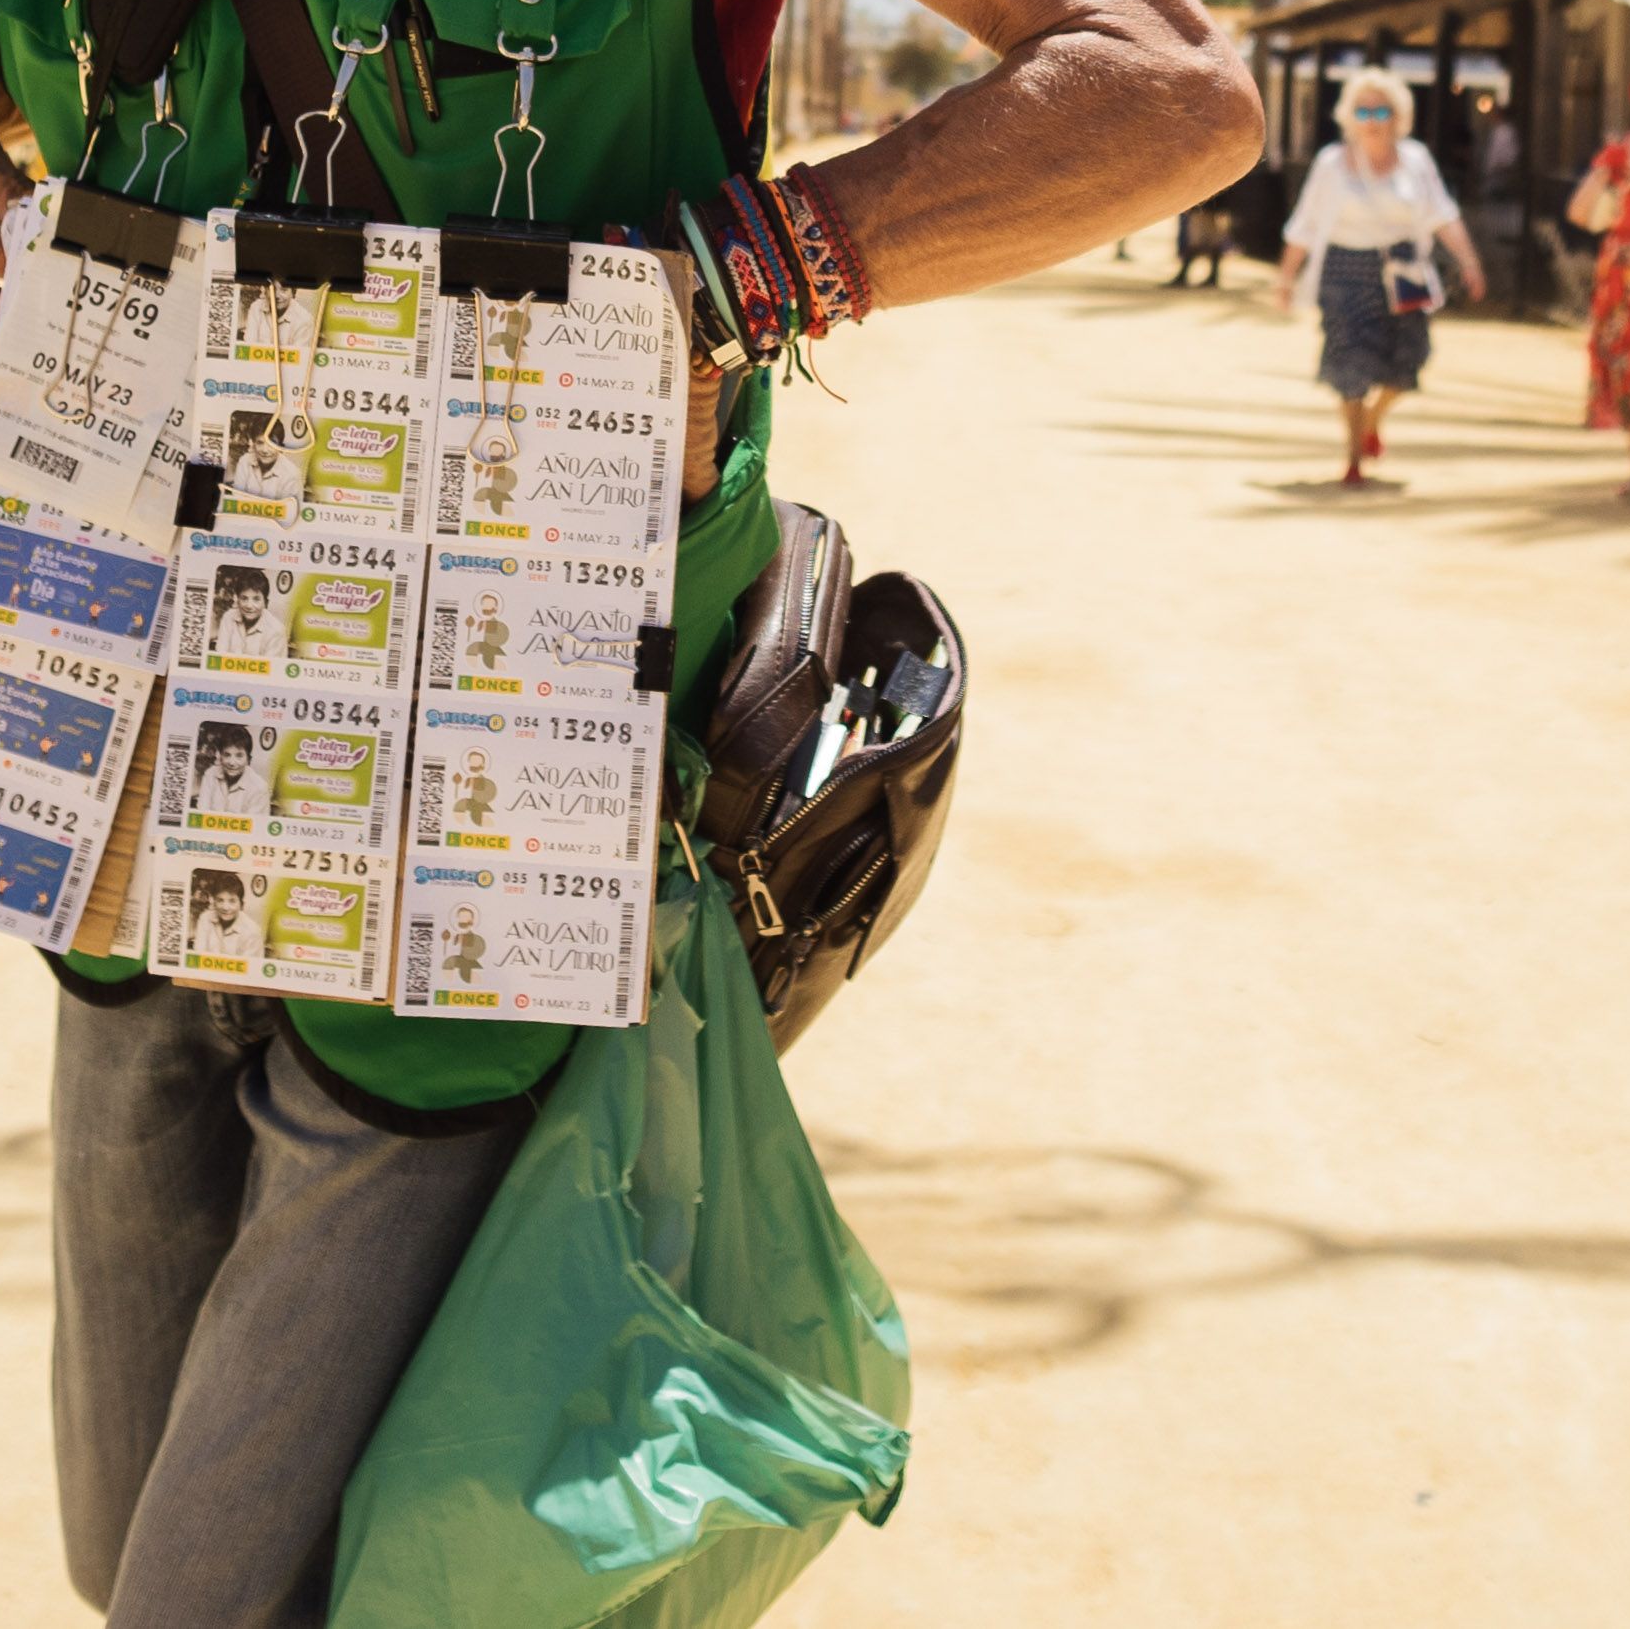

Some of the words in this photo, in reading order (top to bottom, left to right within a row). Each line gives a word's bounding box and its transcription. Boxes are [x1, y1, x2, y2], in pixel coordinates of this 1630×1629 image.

[364, 237, 422, 262] 344
[120, 270, 165, 297] DARIO
[72, 274, 159, 327] 05769
[252, 347, 297, 363] ONCE
[332, 357, 345, 367] 13
[377, 362, 391, 371] 23
[32, 352, 57, 374] 09
[107, 383, 133, 406] 23
[576, 377, 589, 387] 14
[622, 381, 635, 391] 23
[323, 388, 409, 416] 08344
[536, 406, 561, 419] 052
[571, 407, 655, 436] 24653
[98, 418, 137, 448] EUR
[349, 427, 378, 439] letra
[151, 439, 187, 470] EUR
[341, 440, 382, 454] mujer
[242, 502, 286, 517] ONCE
[321, 511, 333, 521] 13
[365, 515, 378, 525] 23
[483, 523, 527, 538] ONCE
[562, 532, 575, 541] 14
[607, 536, 621, 545] 23
[279, 541, 303, 553] 053
[309, 542, 396, 571] 08344
[527, 559, 552, 571] 053
[562, 560, 645, 588] 13298
[334, 582, 363, 594] letra
[325, 595, 367, 609] mujer
[99, 640, 113, 652] 23
[32, 649, 122, 695] 10452
[224, 658, 267, 673] ONCE
[302, 667, 314, 676] 13
[346, 671, 360, 681] 23
[475, 677, 518, 692] ONCE
[554, 685, 566, 695] 14
[598, 689, 612, 698] 23
[262, 697, 286, 709] 054
[293, 698, 381, 727] 08344
[514, 716, 539, 728] 054
[549, 716, 633, 745] 13298
[318, 738, 348, 751] letra
[309, 751, 351, 767] mujer
[206, 816, 250, 831] ONCE
[285, 825, 298, 835] 13
[330, 829, 344, 840] 23
[463, 834, 507, 848] ONCE
[543, 842, 555, 851] 14
[587, 846, 601, 855] 23
[283, 849, 368, 877] 27516
[502, 873, 527, 884] 055
[538, 873, 622, 899] 13298
[203, 956, 245, 971] ONCE
[280, 966, 292, 975] 13
[324, 971, 337, 980] 23
[452, 989, 496, 1003] ONCE
